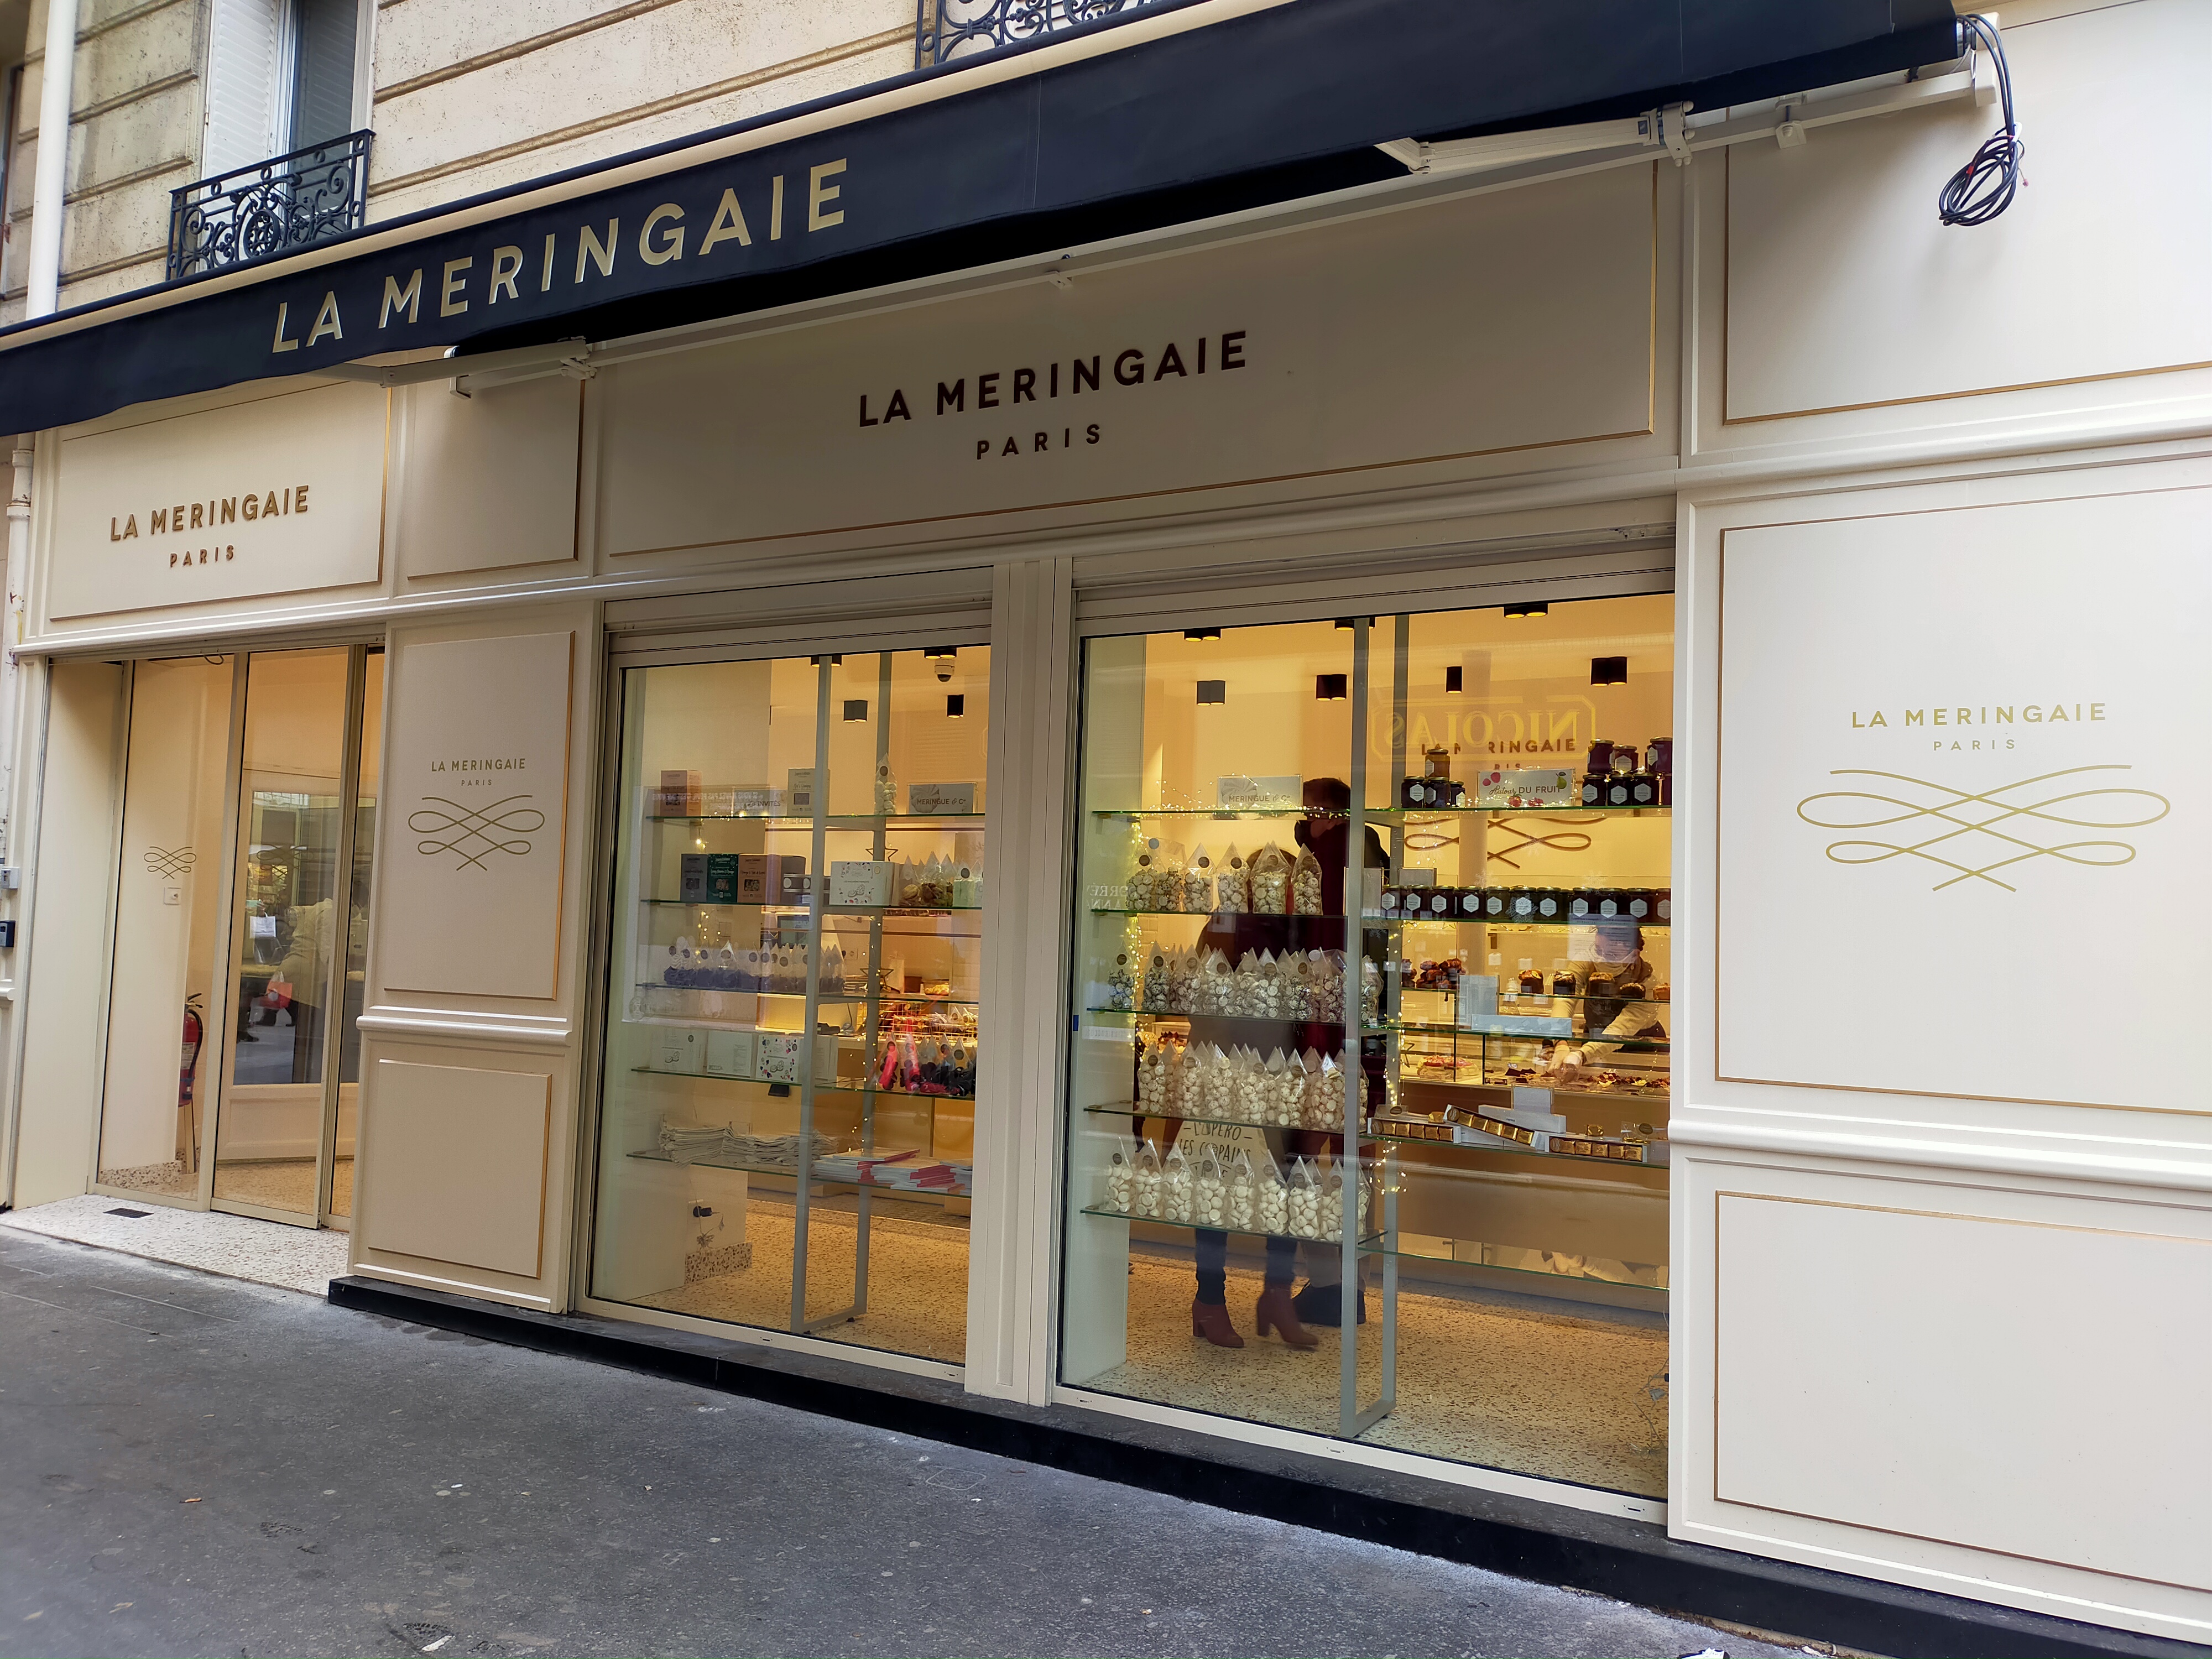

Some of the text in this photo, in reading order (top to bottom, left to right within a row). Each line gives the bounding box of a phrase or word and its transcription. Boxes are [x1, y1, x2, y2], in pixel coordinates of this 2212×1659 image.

[273, 158, 847, 353] LA MERINGAIE
[859, 331, 1246, 427] LA MERINGAIE
[977, 424, 1100, 460] PARIS
[111, 485, 309, 541] LA MERINGAIE
[170, 545, 234, 568] PARIS
[1852, 702, 2106, 728] LA MERINGAIE
[1454, 739, 1575, 754] RINGAIE
[1933, 739, 2016, 751] PARIS
[431, 758, 525, 772] LA MERINGAIE
[1489, 785, 1517, 795] Autour
